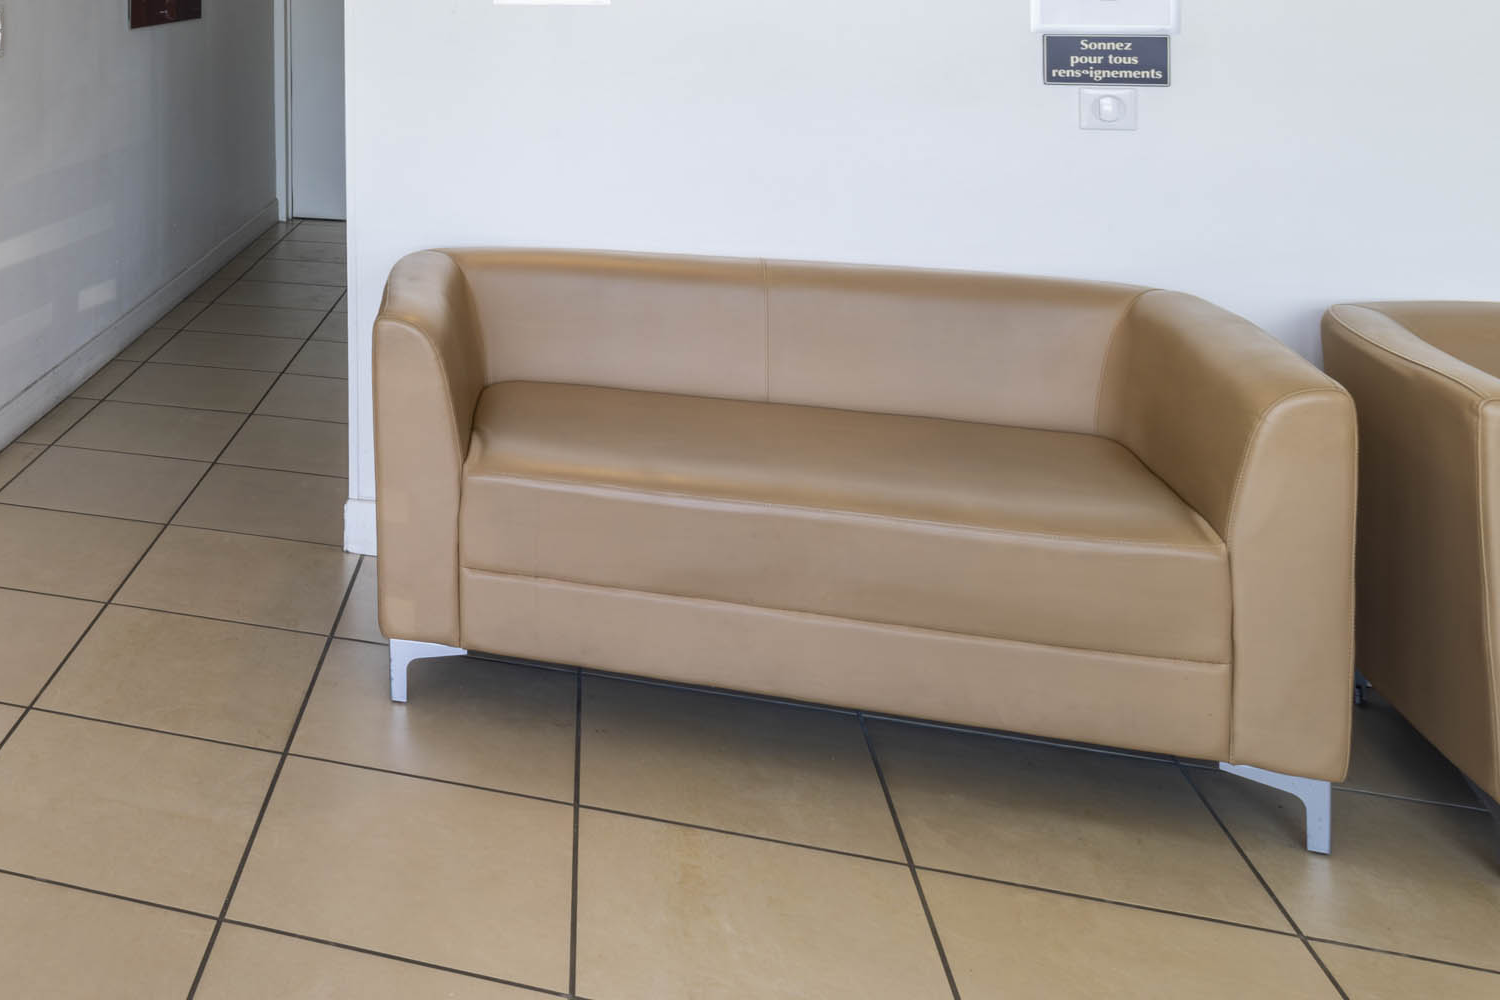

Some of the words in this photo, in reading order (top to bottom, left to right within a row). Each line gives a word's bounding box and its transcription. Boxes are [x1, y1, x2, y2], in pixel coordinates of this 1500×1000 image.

[1080, 39, 1133, 51] Sonnez
[1069, 55, 1104, 67] pour
[1108, 54, 1139, 65] tous
